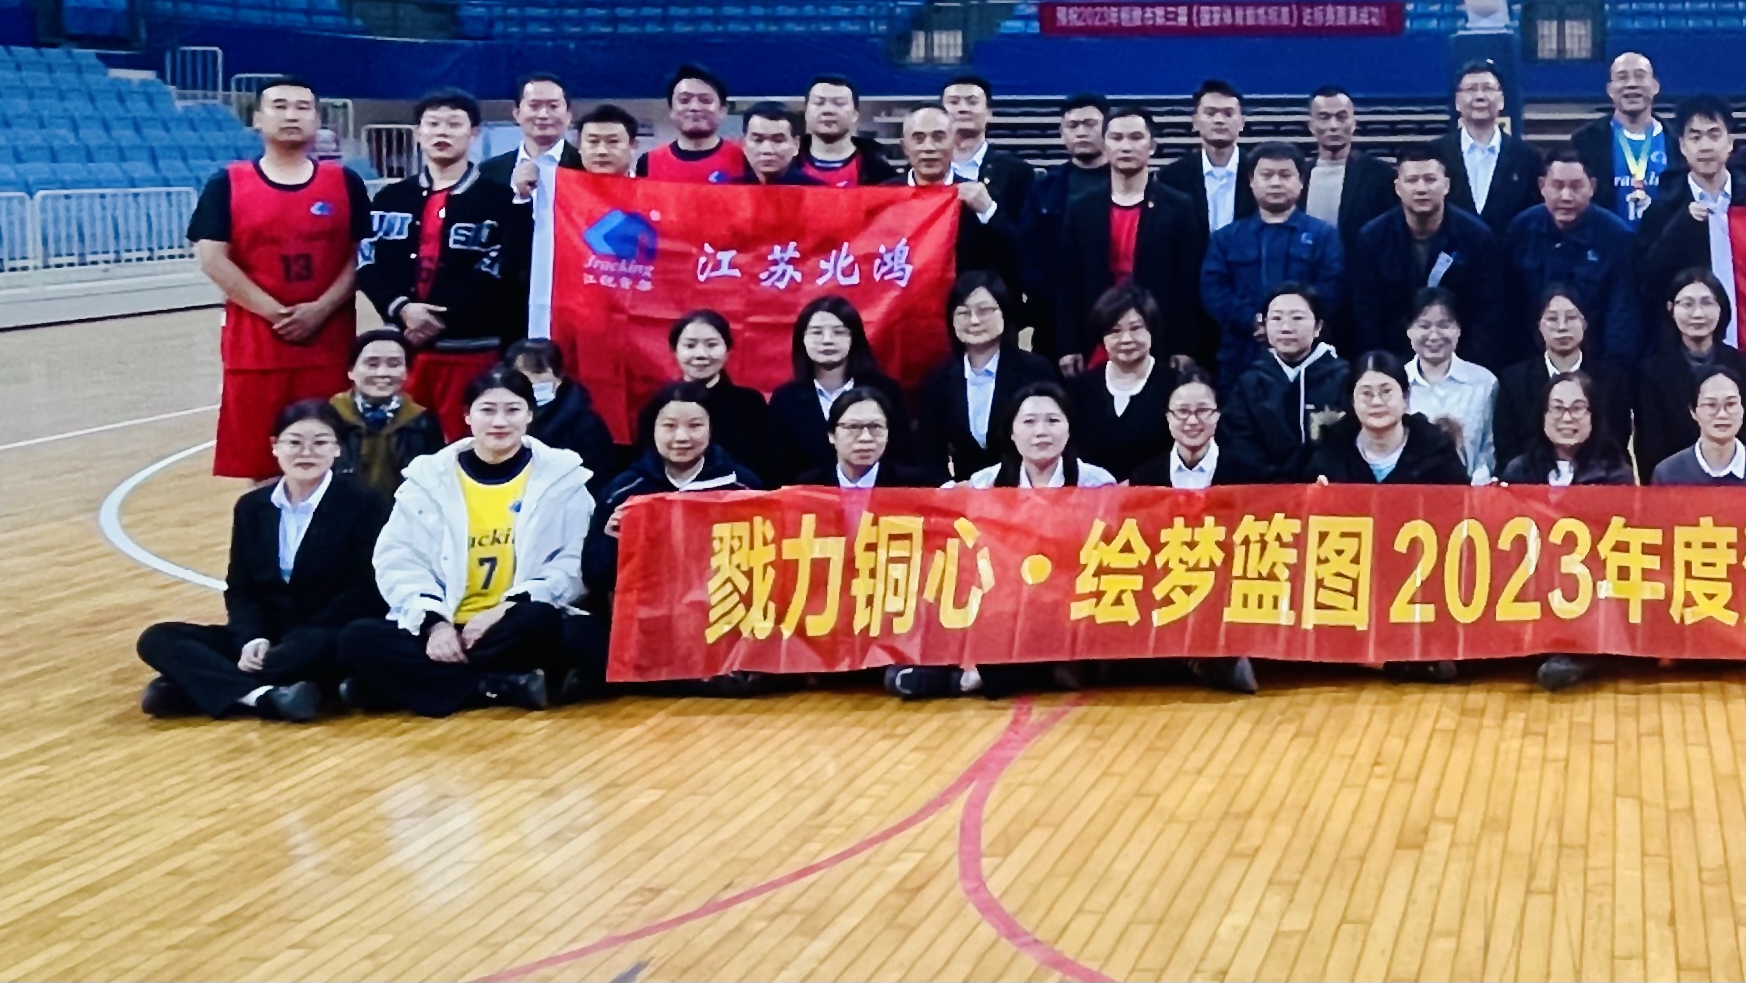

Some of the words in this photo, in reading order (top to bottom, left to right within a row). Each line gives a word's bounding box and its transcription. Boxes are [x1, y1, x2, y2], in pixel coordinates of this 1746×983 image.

[279, 253, 314, 284] 13
[697, 237, 914, 289] 江苏北鸿
[477, 556, 498, 591] 7
